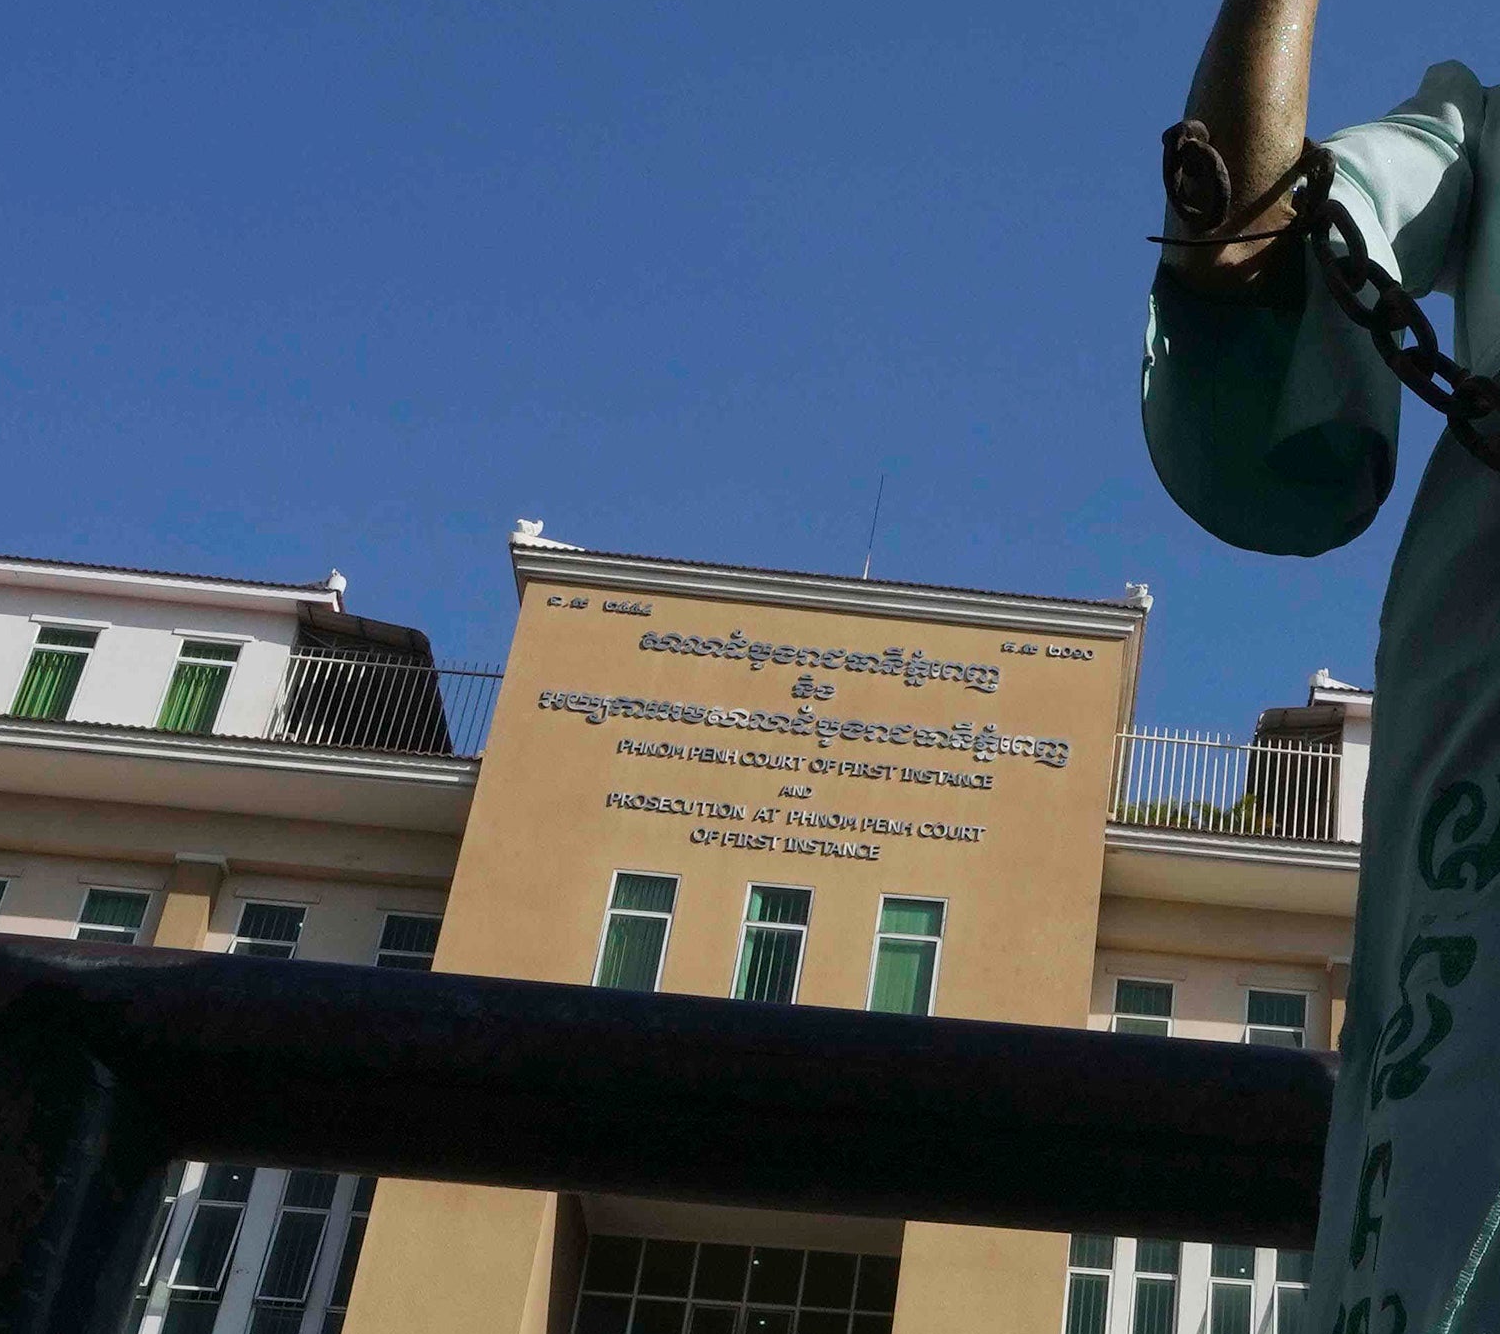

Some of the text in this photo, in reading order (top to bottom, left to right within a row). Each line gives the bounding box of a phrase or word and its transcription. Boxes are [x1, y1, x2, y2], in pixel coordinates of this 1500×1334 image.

[639, 628, 1001, 694] សាលាដំបូងរាជធានីភ្នំពេញ
[792, 673, 836, 700] និង
[617, 738, 994, 789] PHNOM PENH COURT OF FIRST INSTANCE
[778, 784, 814, 800] AND
[606, 791, 988, 842] PROSECUTION AT PHNOM PENH COURT
[690, 827, 881, 860] OF FIRST INSTANCE
